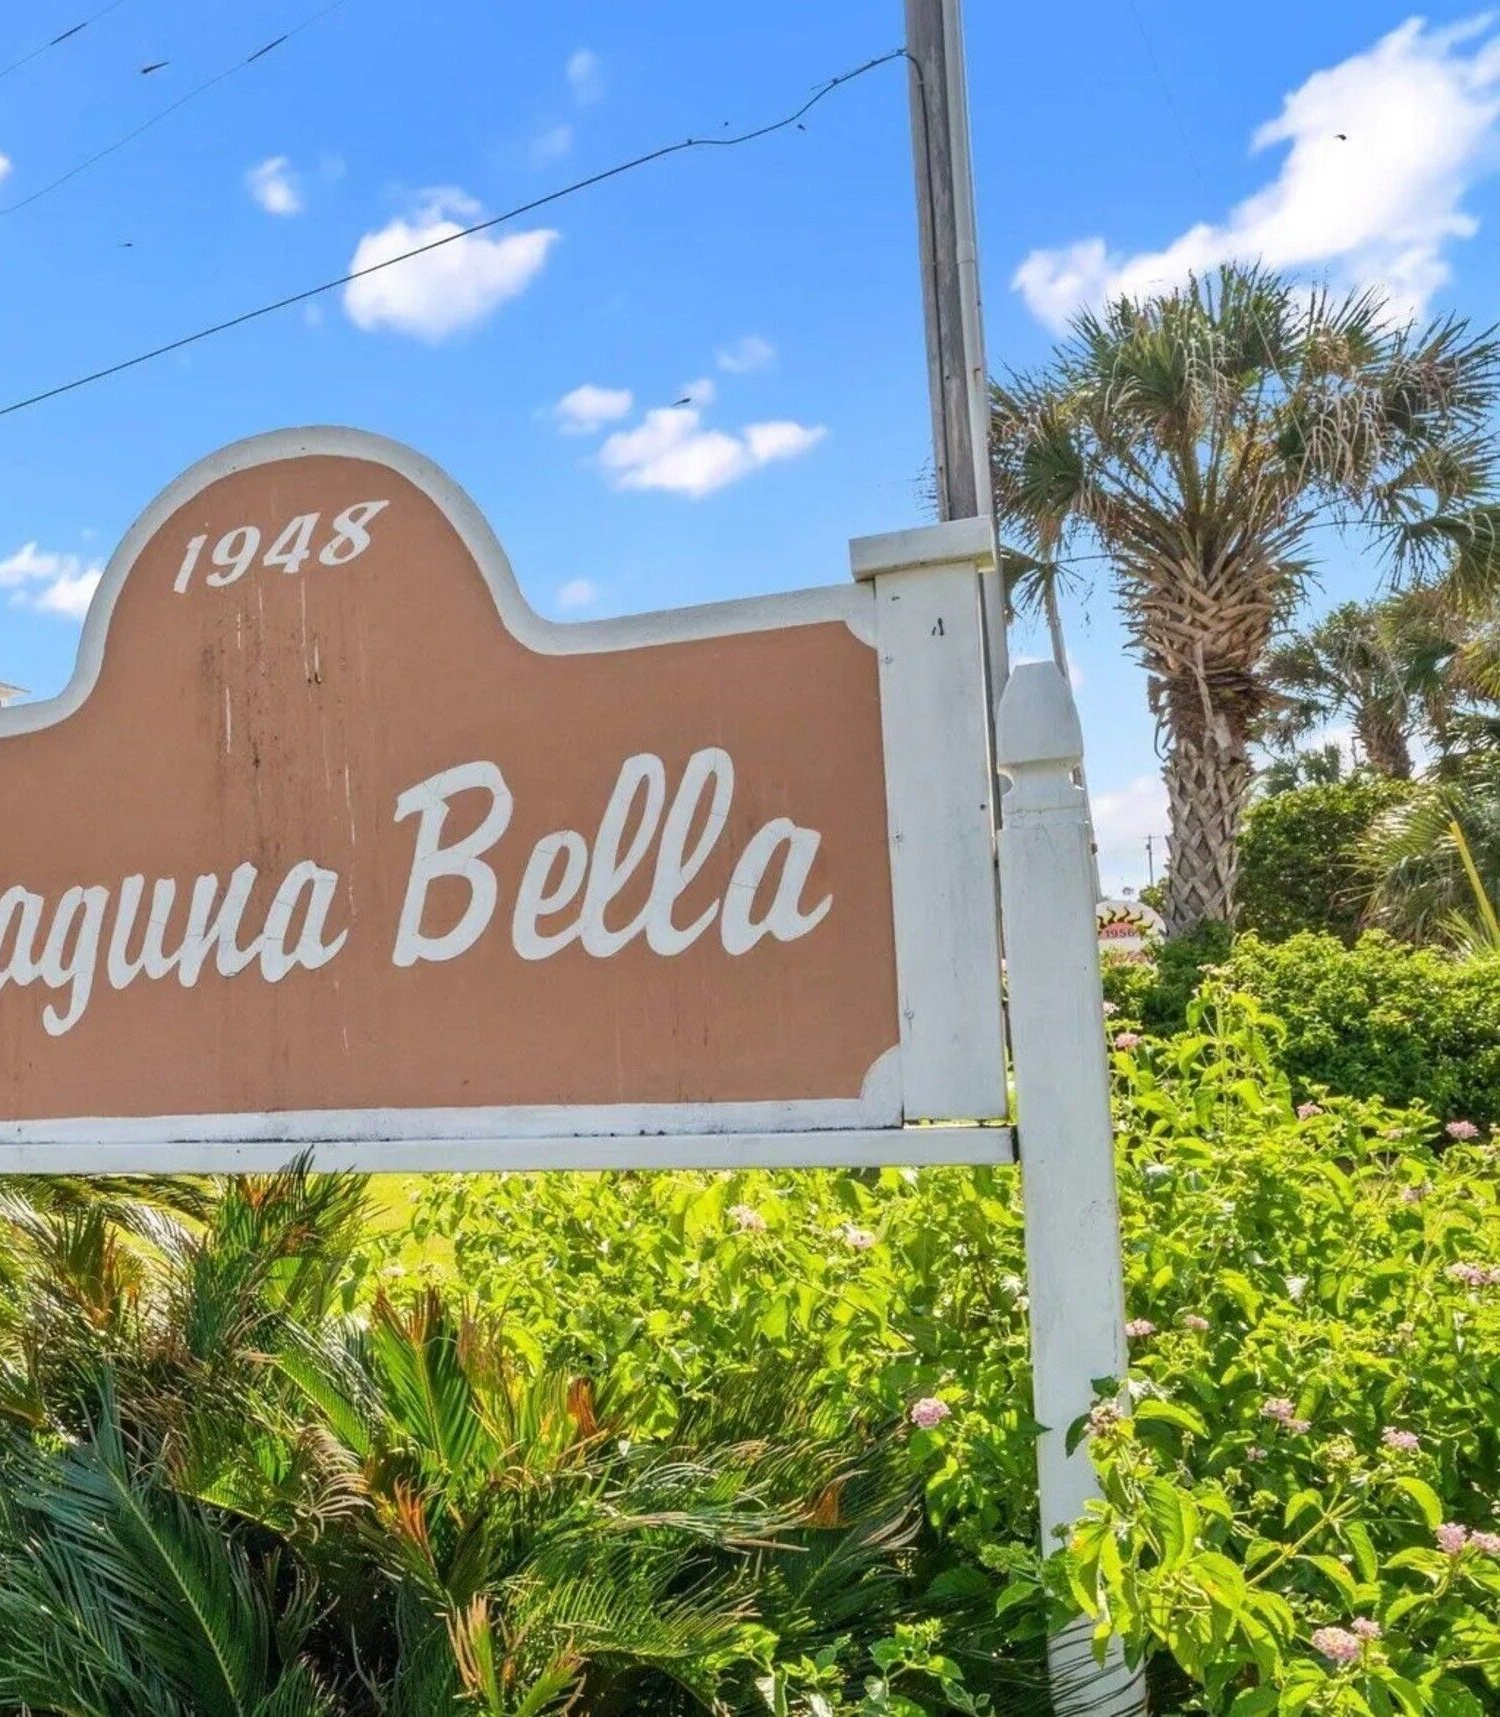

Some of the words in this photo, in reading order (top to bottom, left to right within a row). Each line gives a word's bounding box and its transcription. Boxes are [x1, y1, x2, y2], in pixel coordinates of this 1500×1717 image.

[173, 499, 390, 594] 1948
[391, 746, 833, 968] Bella
[1105, 928, 1135, 938] 1956
